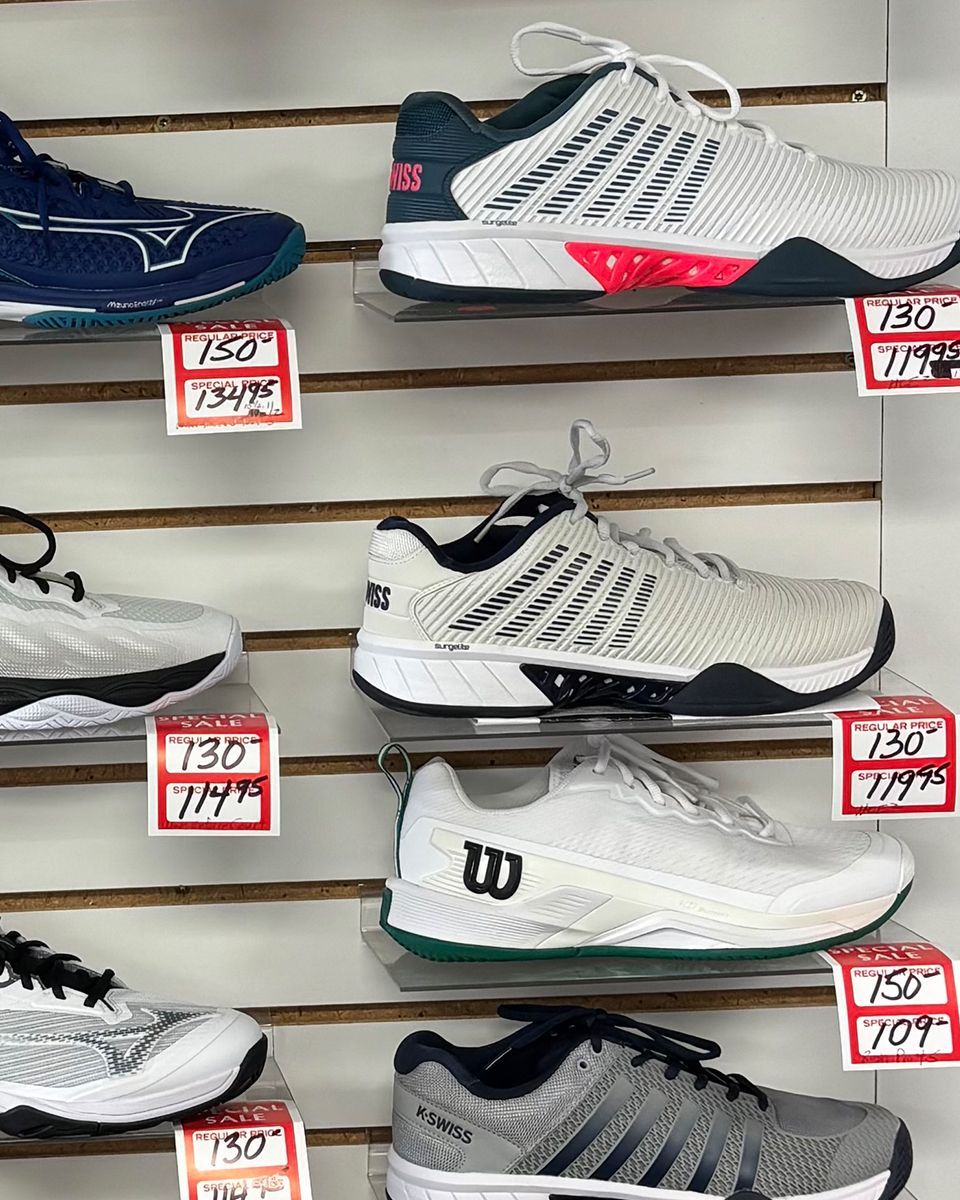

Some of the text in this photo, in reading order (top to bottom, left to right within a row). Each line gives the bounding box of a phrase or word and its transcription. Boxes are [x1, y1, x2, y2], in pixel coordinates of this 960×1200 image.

[867, 298, 921, 306] REGULAR
[180, 720, 242, 728] SALE
[854, 721, 944, 732] REGULAR PRICE
[827, 944, 934, 954] SPECIAL
[857, 952, 922, 961] SALE
[205, 1113, 266, 1124] SALE
